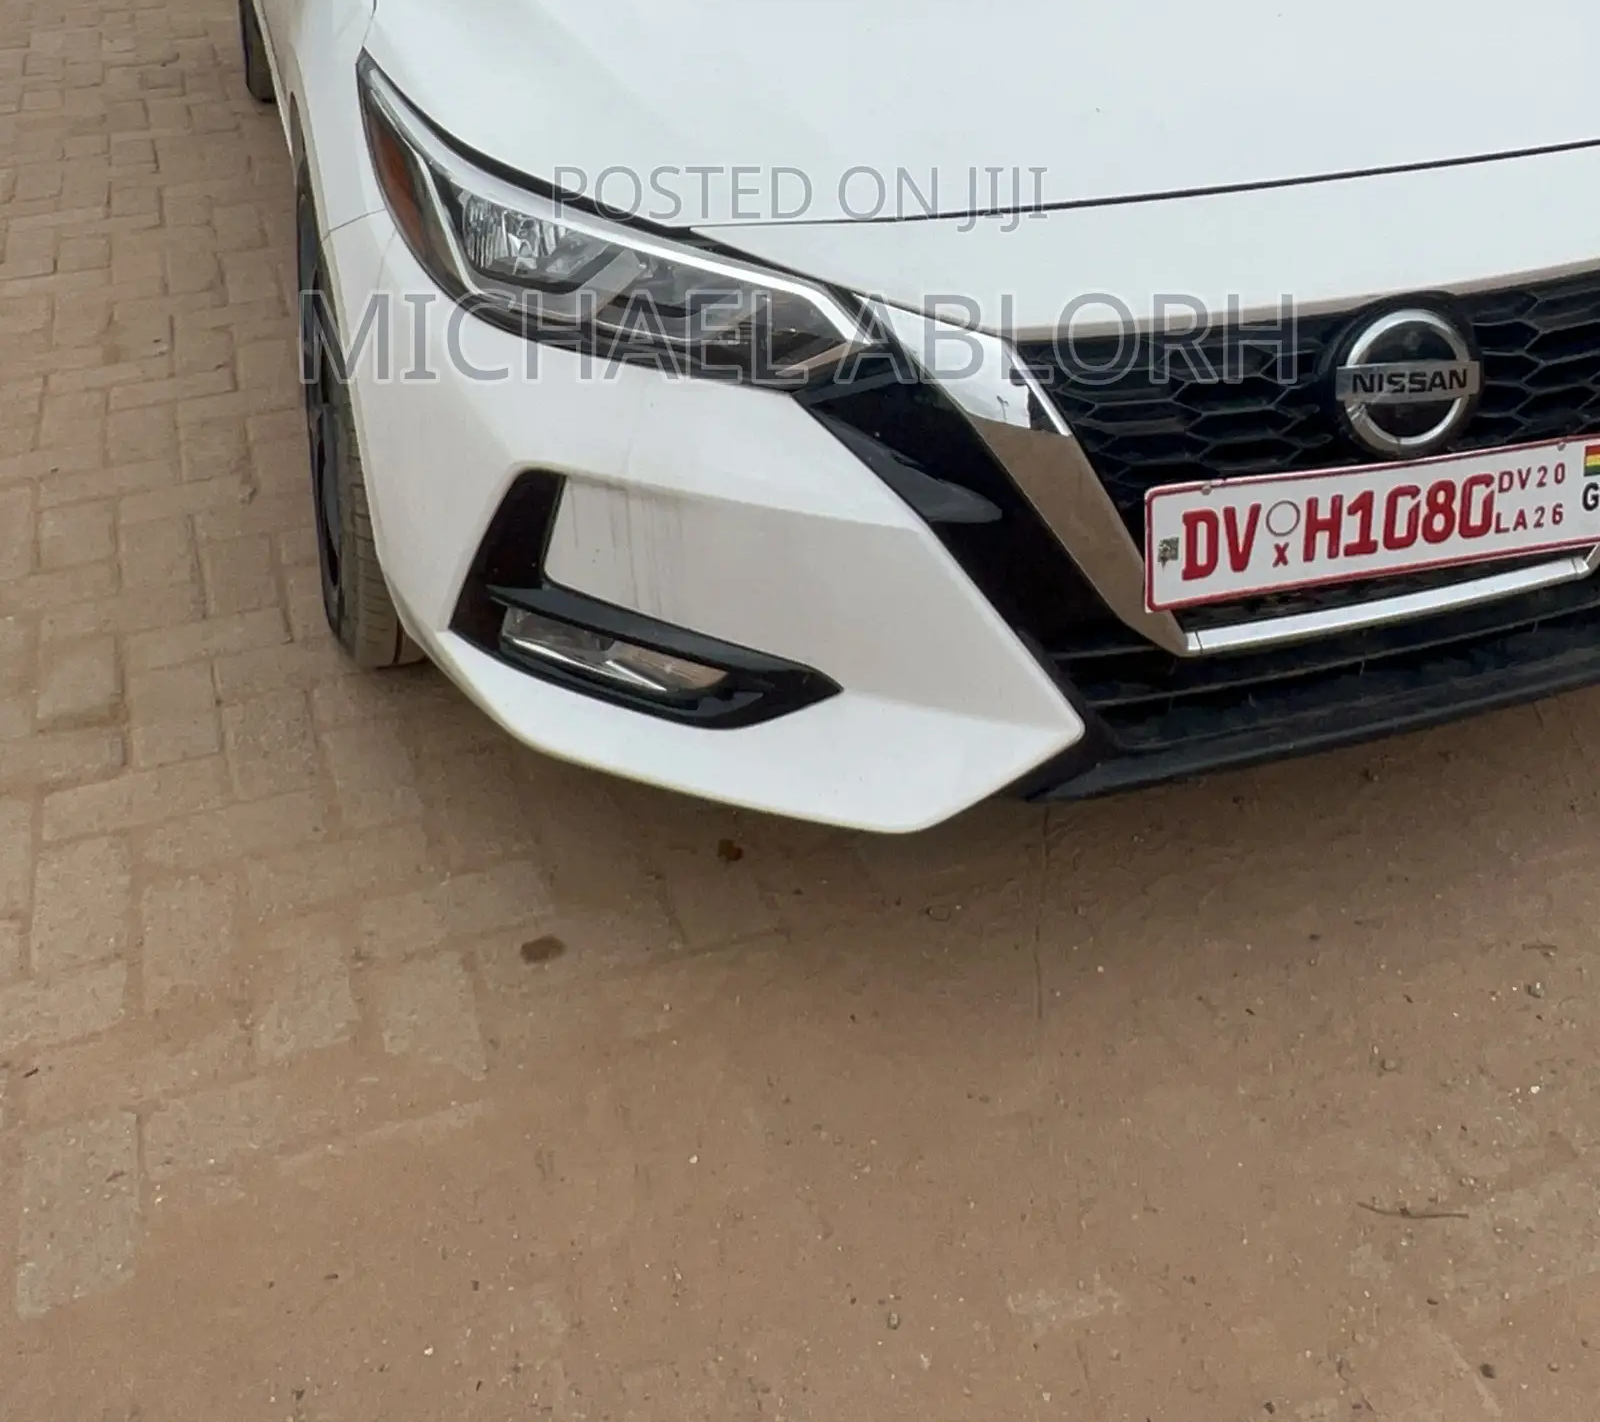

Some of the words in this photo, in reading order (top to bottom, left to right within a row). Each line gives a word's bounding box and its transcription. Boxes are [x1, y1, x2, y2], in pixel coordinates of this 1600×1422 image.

[1352, 368, 1468, 393] NISSAN
[1182, 503, 1262, 581] DV
[1303, 473, 1495, 562] H1080
